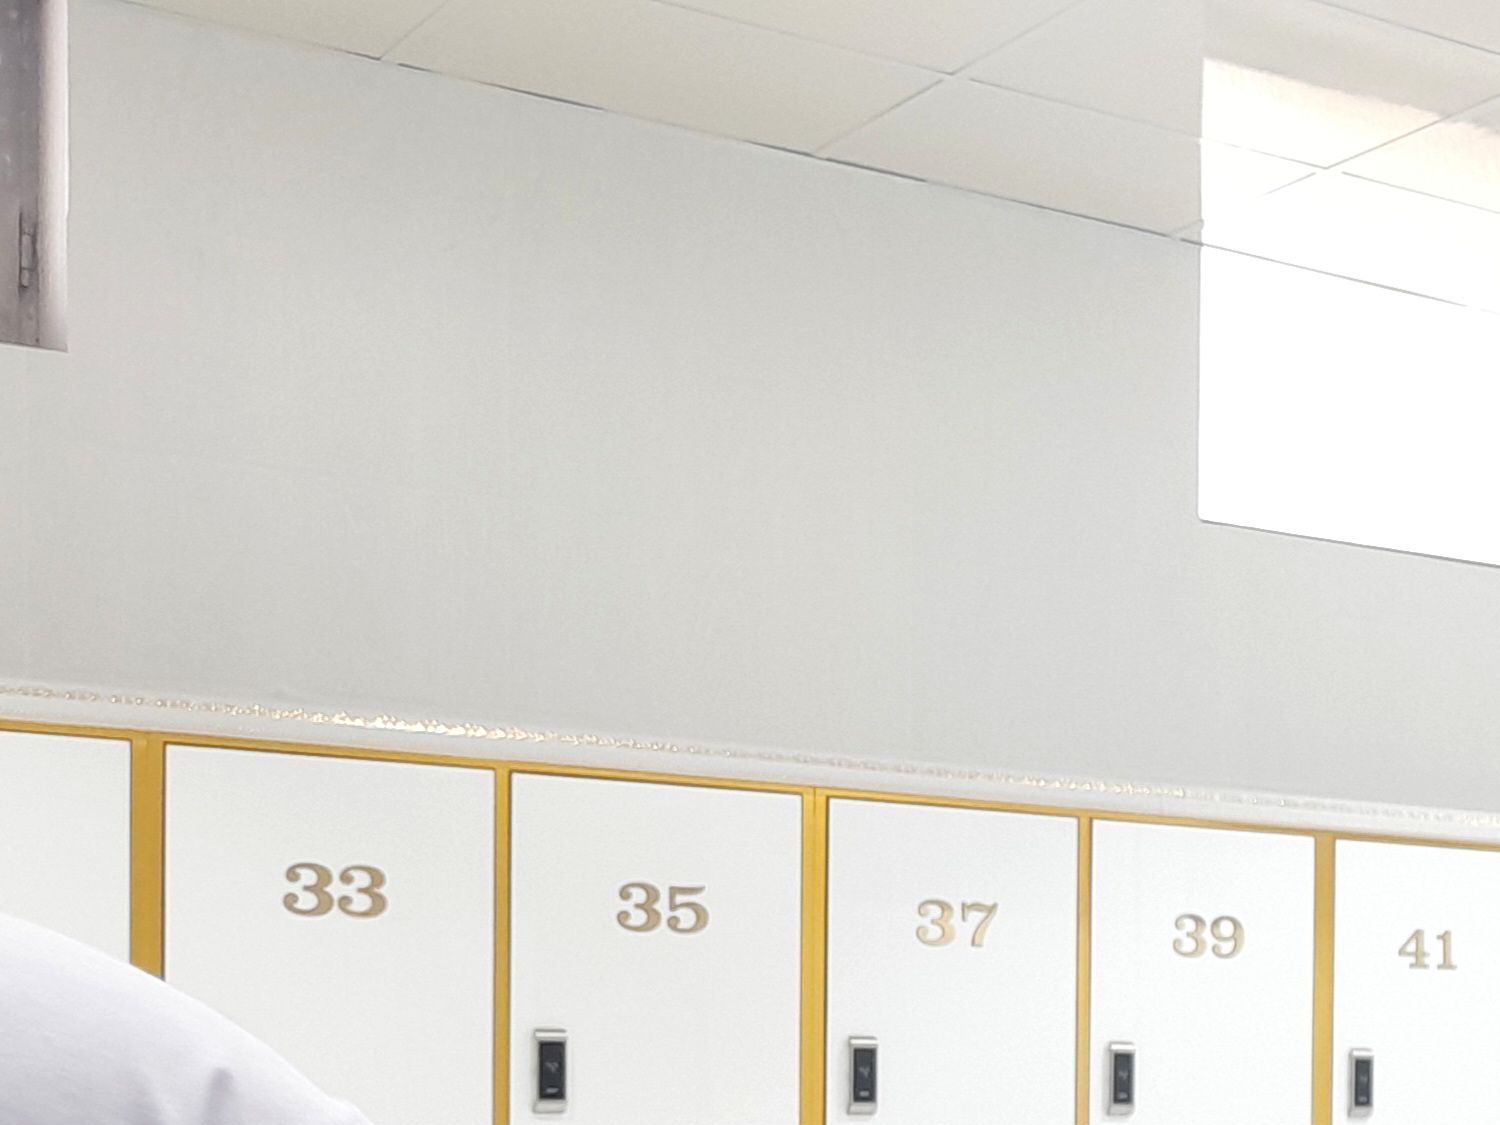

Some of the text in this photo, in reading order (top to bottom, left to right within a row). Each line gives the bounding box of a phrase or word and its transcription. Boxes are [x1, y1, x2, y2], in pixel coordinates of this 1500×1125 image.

[281, 861, 389, 919] 33
[615, 881, 710, 935] 35
[915, 898, 999, 948] 37
[1171, 913, 1245, 960] 39
[1397, 928, 1458, 971] 41
